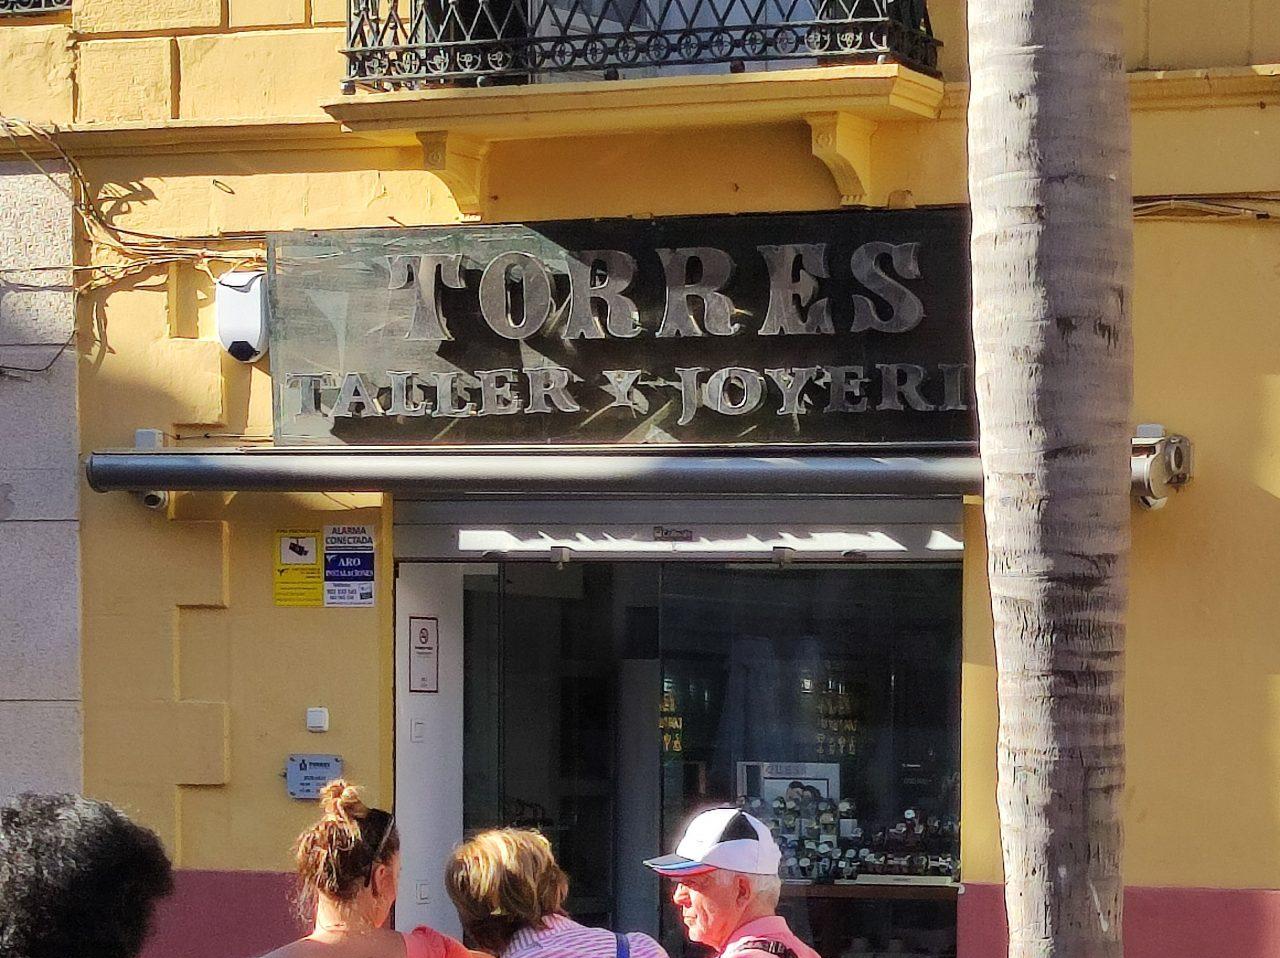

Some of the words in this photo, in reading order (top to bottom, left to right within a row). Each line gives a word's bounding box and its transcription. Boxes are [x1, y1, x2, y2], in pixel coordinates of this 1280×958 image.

[386, 242, 924, 341] TORRES
[285, 365, 580, 417] TALLER
[600, 368, 643, 408] Y
[332, 526, 366, 534] ALARMA
